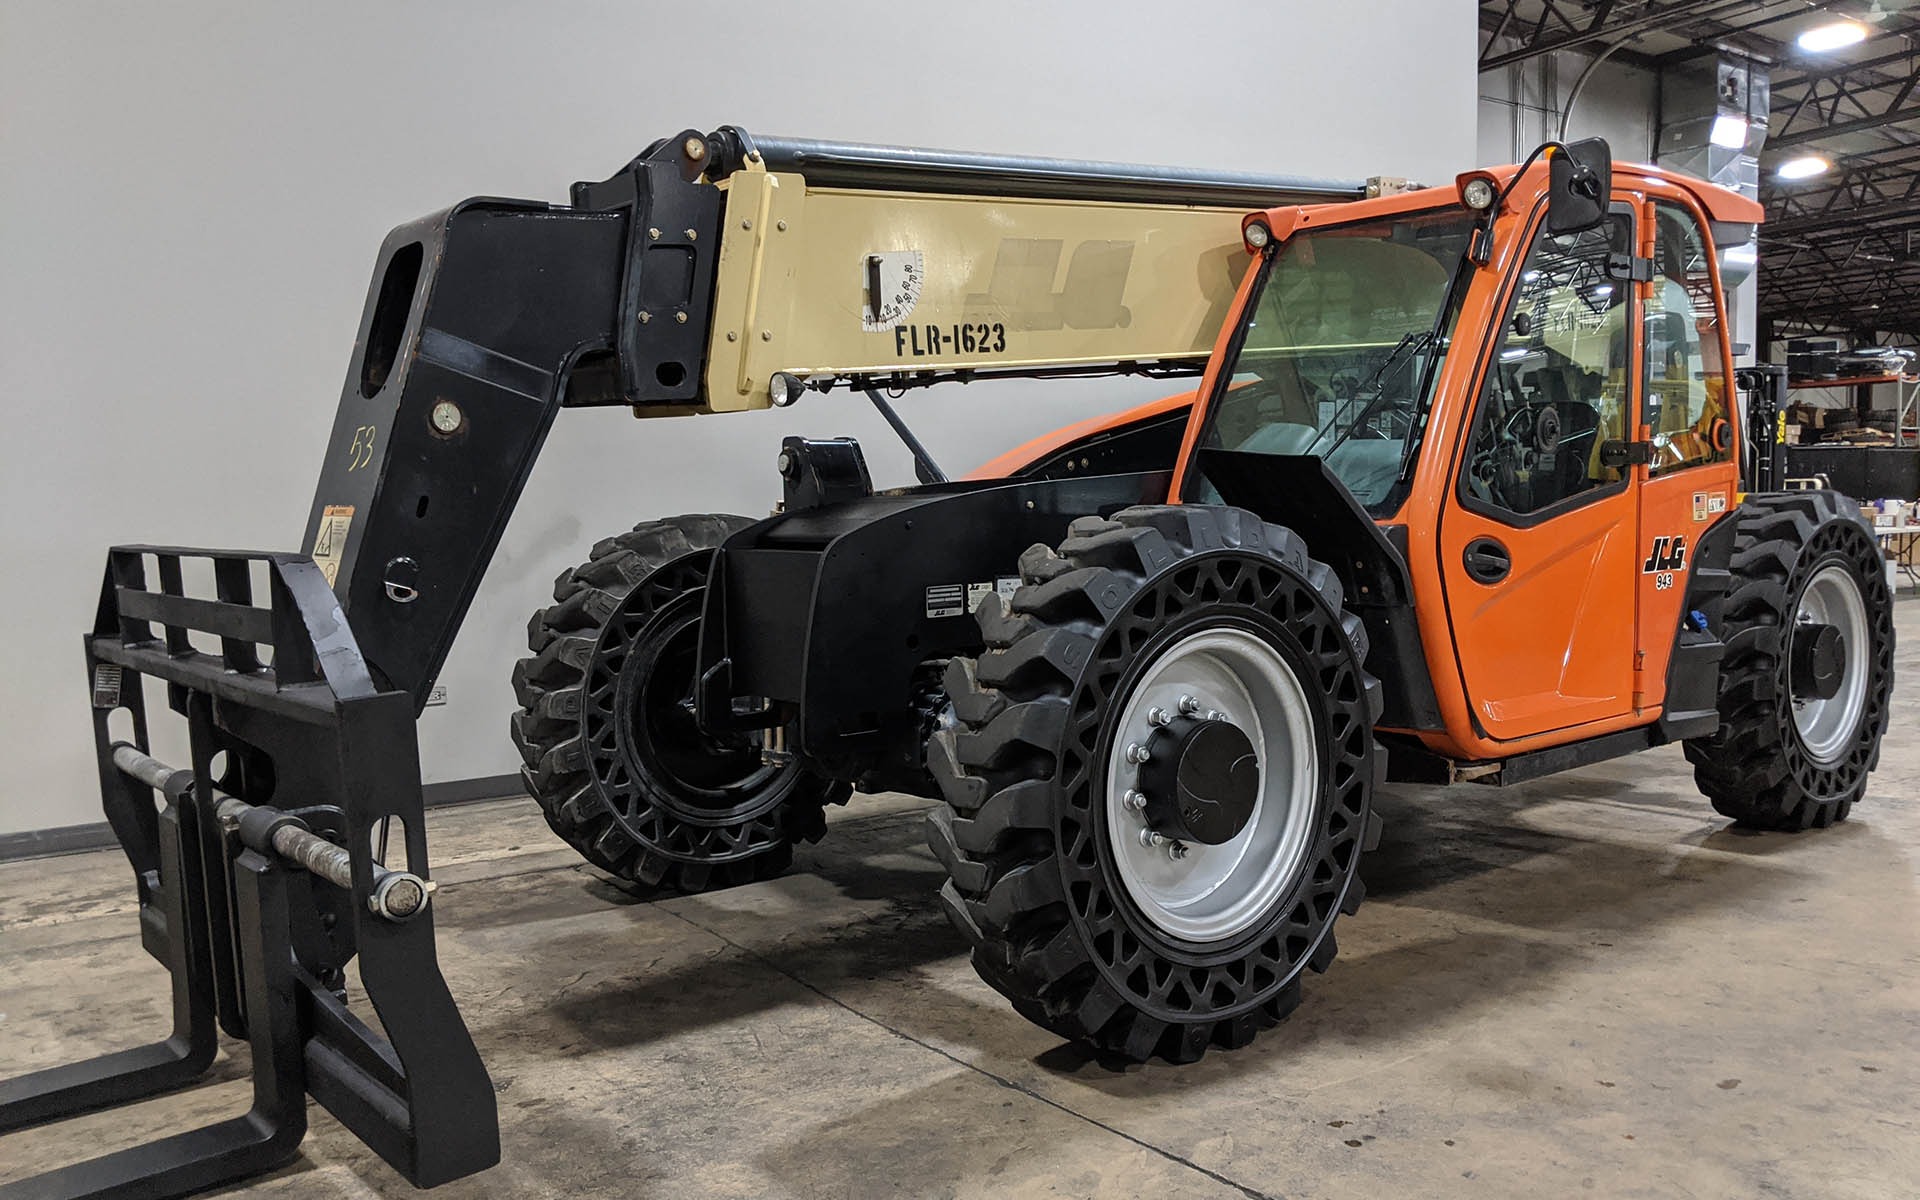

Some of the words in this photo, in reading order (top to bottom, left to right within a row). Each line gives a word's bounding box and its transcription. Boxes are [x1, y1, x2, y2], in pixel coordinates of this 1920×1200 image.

[904, 264, 913, 273] 80
[902, 280, 911, 291] 60
[909, 274, 918, 284] 70
[903, 292, 912, 303] 50
[895, 323, 1006, 357] FLR-1623
[348, 425, 376, 472] 53
[1643, 536, 1687, 573] JLG
[1656, 574, 1673, 590] 943
